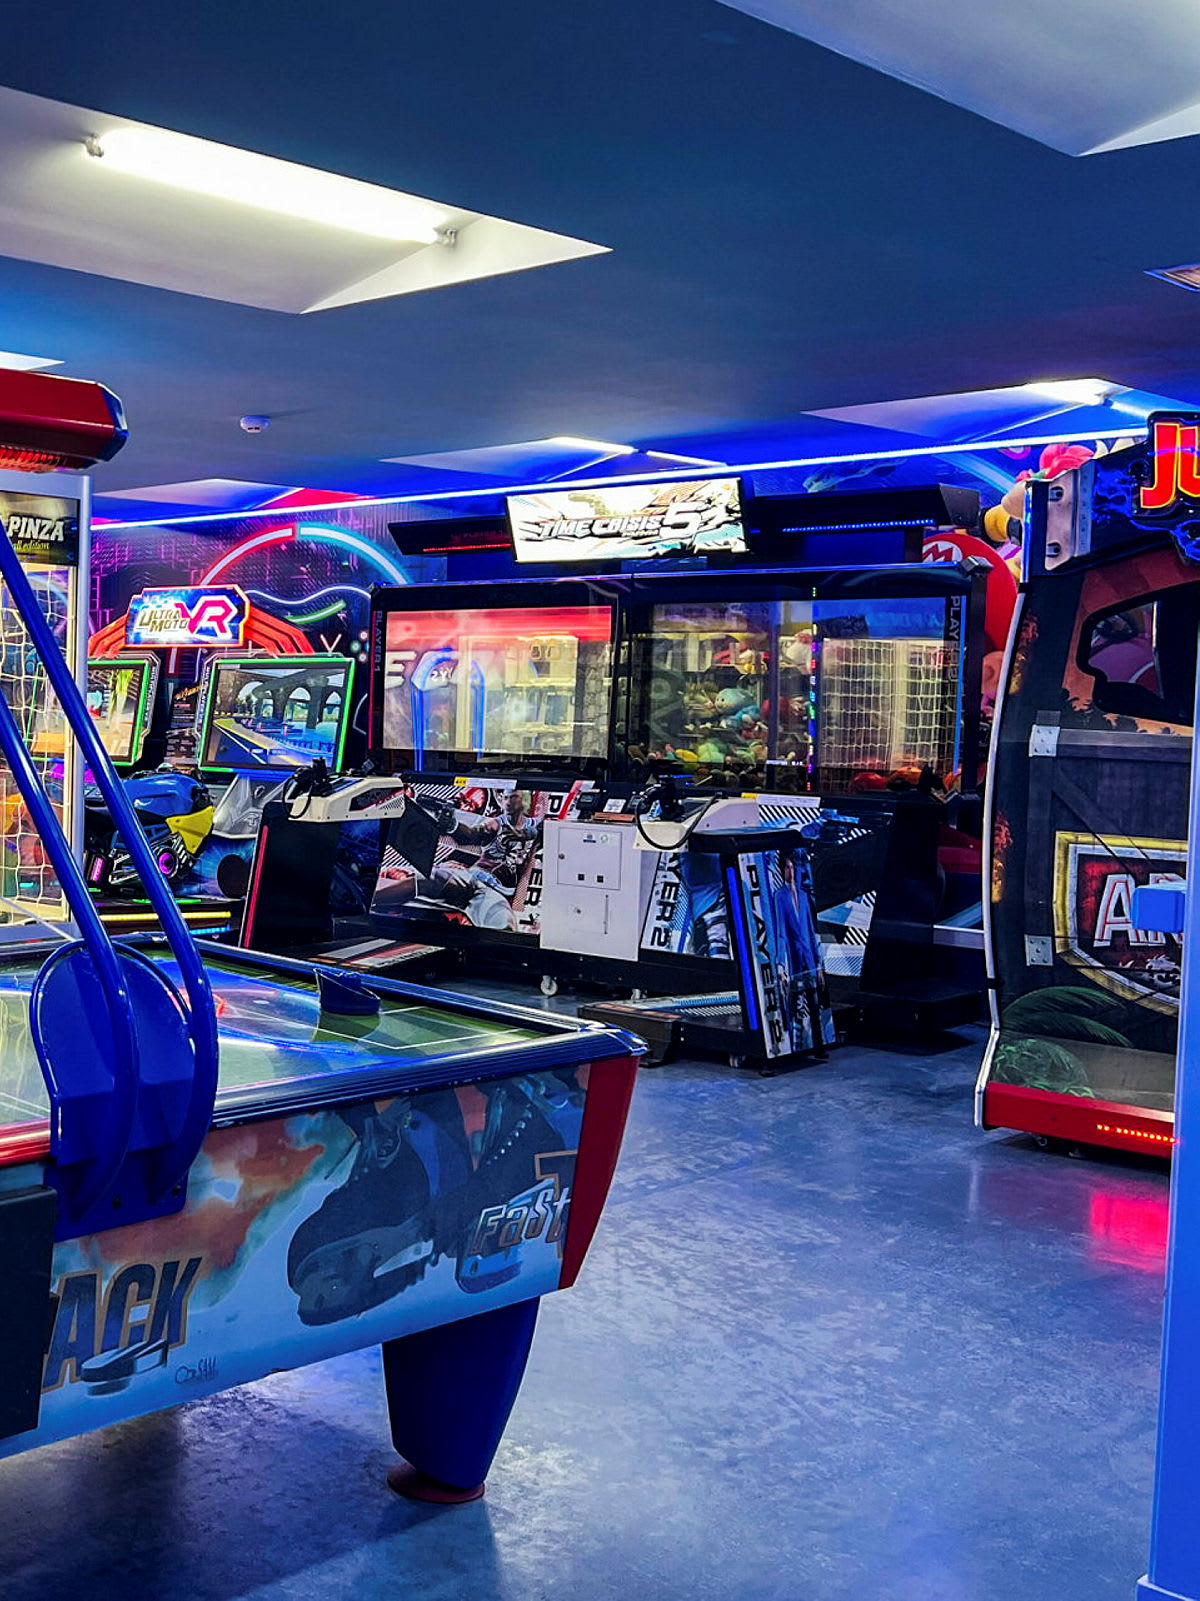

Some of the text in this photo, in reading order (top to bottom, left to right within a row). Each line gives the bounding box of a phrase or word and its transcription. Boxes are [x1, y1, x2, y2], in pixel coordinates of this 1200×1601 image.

[7, 514, 65, 541] PINZA
[539, 520, 591, 539] TIME
[591, 515, 662, 536] CRISIS
[660, 501, 703, 539] 5
[139, 598, 235, 636] ULTRA VR
[149, 618, 189, 633] MOTO
[374, 610, 383, 663] PLAYER
[650, 926, 670, 947] 2
[746, 864, 778, 1013] PLAYER
[41, 1256, 203, 1393] ACK
